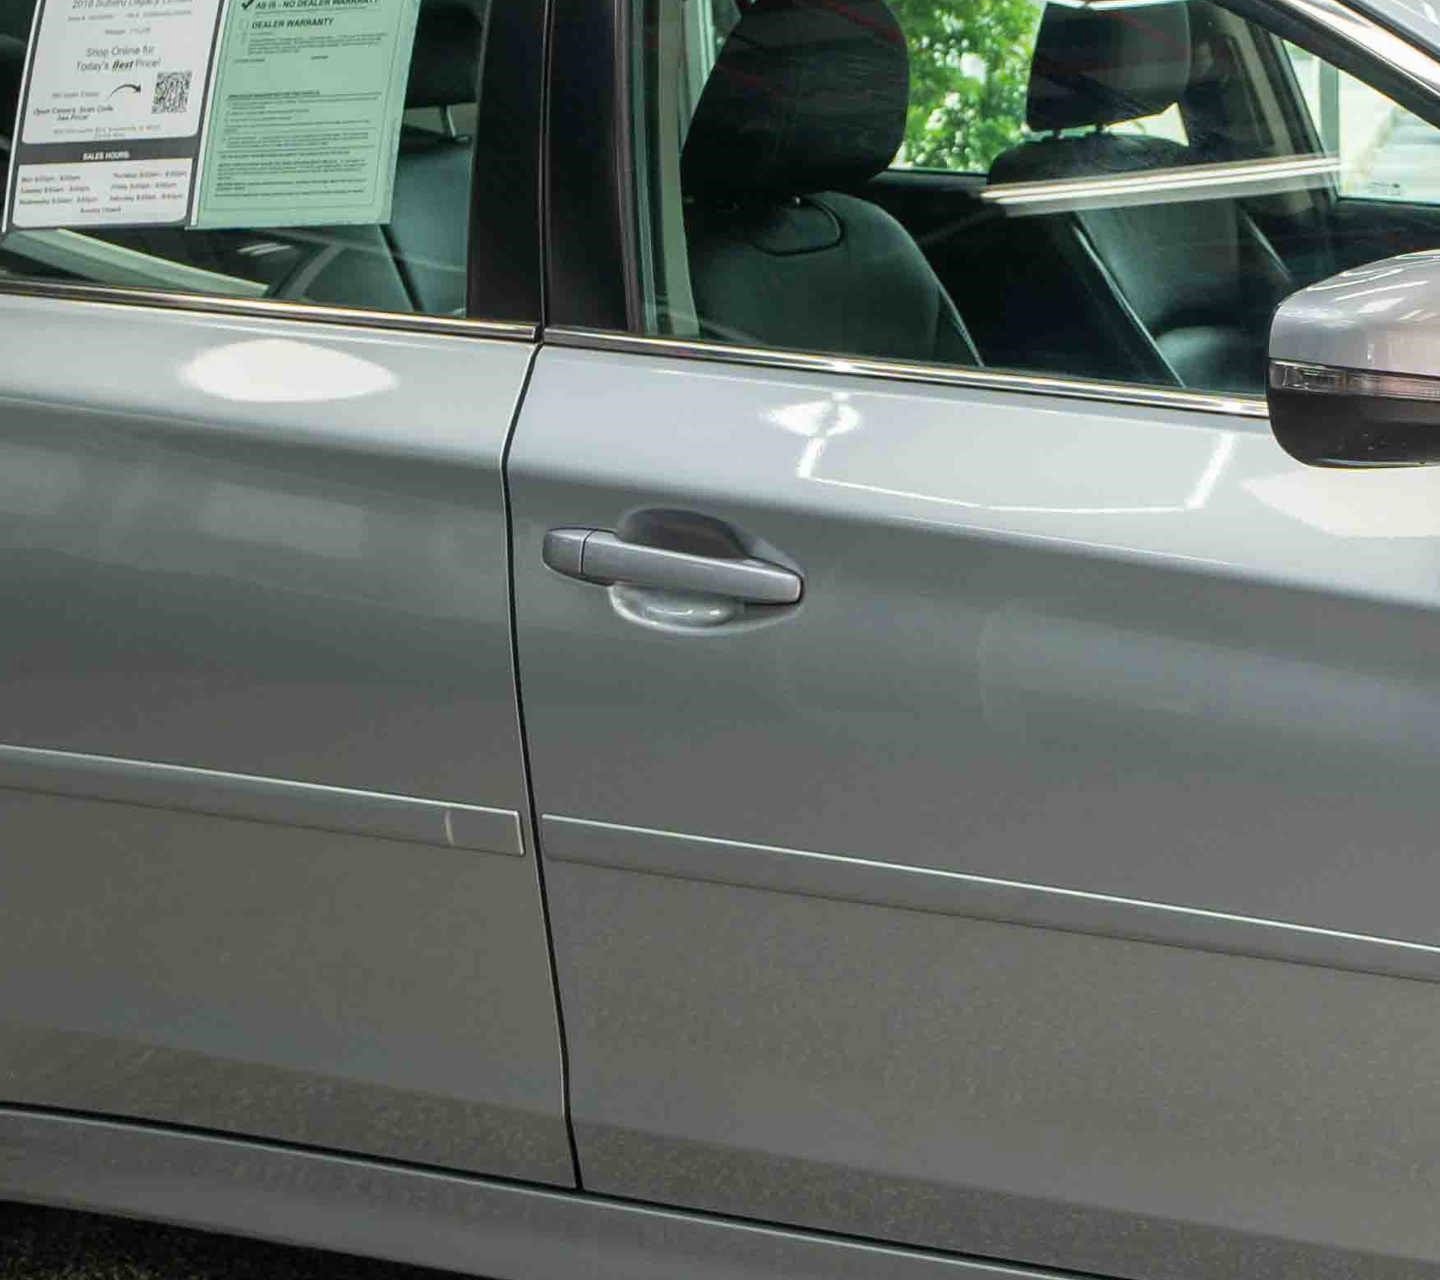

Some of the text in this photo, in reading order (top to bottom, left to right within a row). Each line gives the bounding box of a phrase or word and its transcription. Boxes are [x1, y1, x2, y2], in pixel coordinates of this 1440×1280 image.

[255, 1, 267, 10] AS
[268, 0, 277, 9] IS
[283, 0, 296, 8] NO
[252, 17, 334, 29] DEALER WARRANTY
[85, 48, 109, 59] Shop
[110, 46, 140, 56] Online
[76, 60, 110, 72] Today's
[112, 60, 135, 71] Best
[82, 152, 104, 161] SALES
